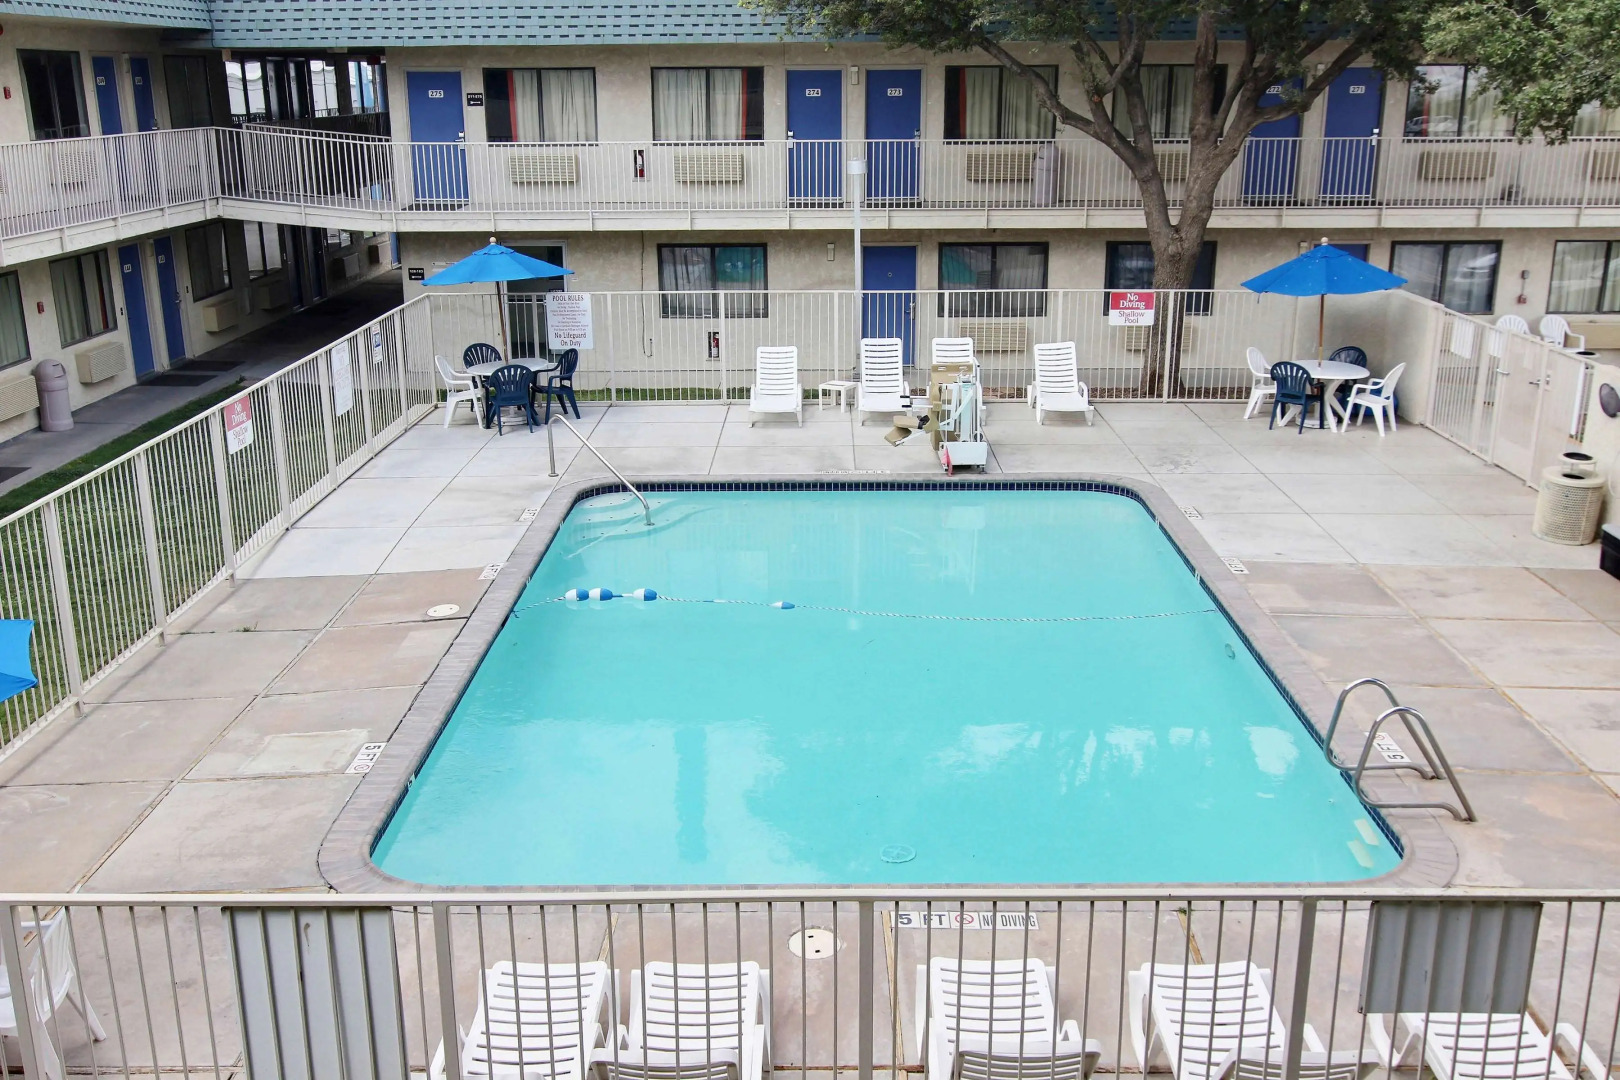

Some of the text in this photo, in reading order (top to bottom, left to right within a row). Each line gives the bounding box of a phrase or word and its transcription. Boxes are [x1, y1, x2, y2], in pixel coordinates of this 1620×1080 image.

[1127, 292, 1138, 300] No
[1120, 300, 1146, 308] Diving
[564, 332, 587, 340] Lifeguard
[570, 340, 582, 348] Duty
[234, 402, 242, 412] No
[232, 411, 248, 426] Diving
[1376, 742, 1399, 750] FT
[357, 754, 376, 762] FT
[899, 914, 912, 925] 5
[923, 914, 946, 926] FT
[1001, 914, 1036, 926] DIVING
